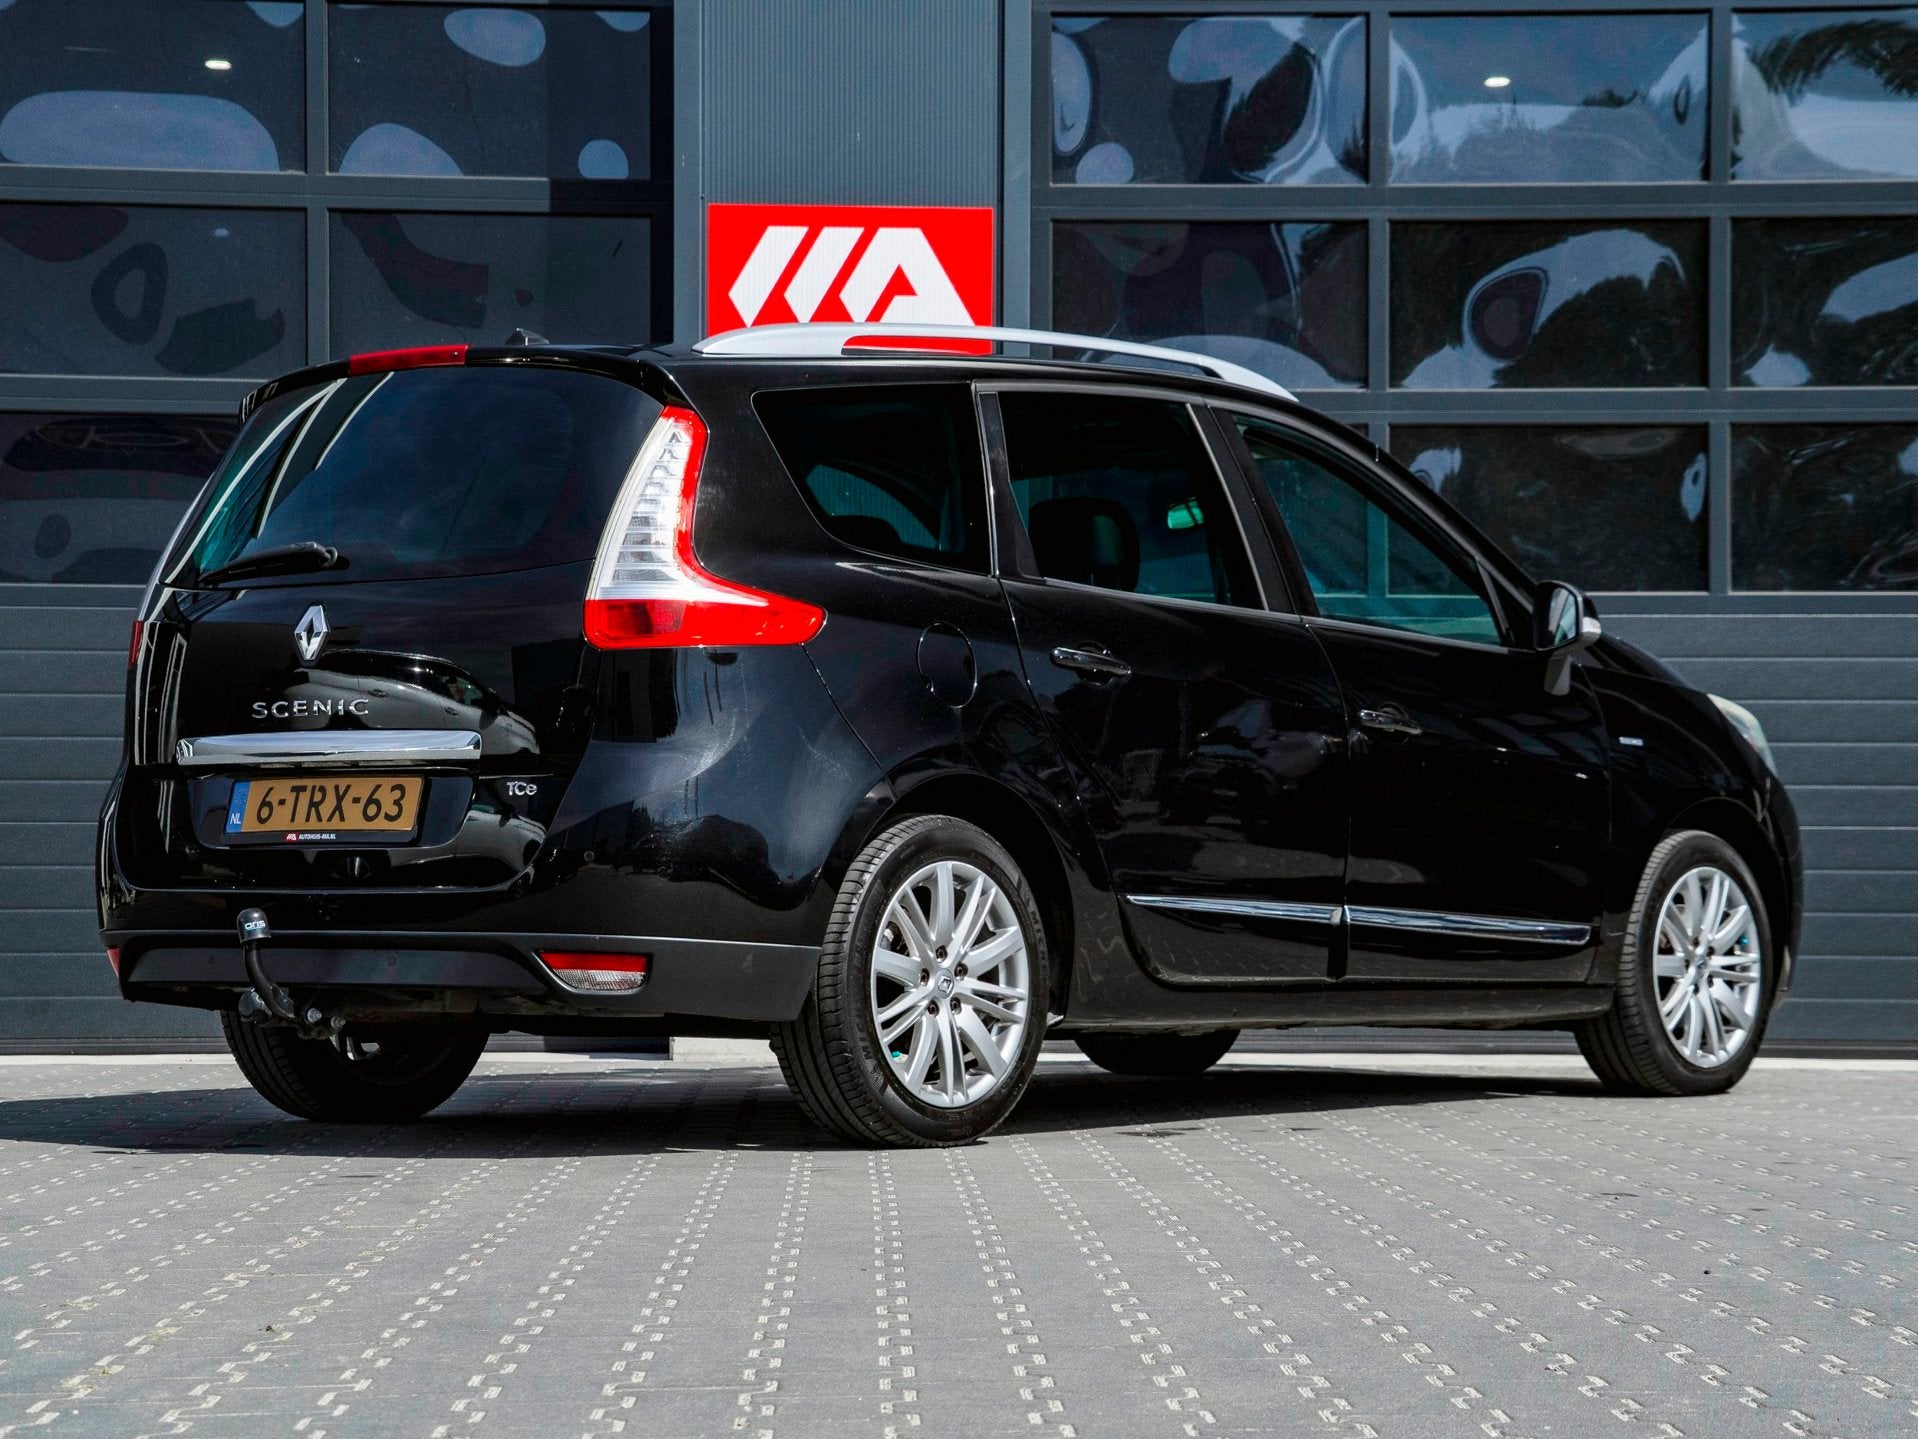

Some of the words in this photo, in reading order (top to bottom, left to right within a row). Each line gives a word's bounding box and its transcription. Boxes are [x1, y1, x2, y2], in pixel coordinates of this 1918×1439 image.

[251, 698, 369, 719] SCENIC
[506, 781, 538, 796] TCe
[256, 783, 407, 825] 6-TRX-63
[230, 813, 242, 825] NL
